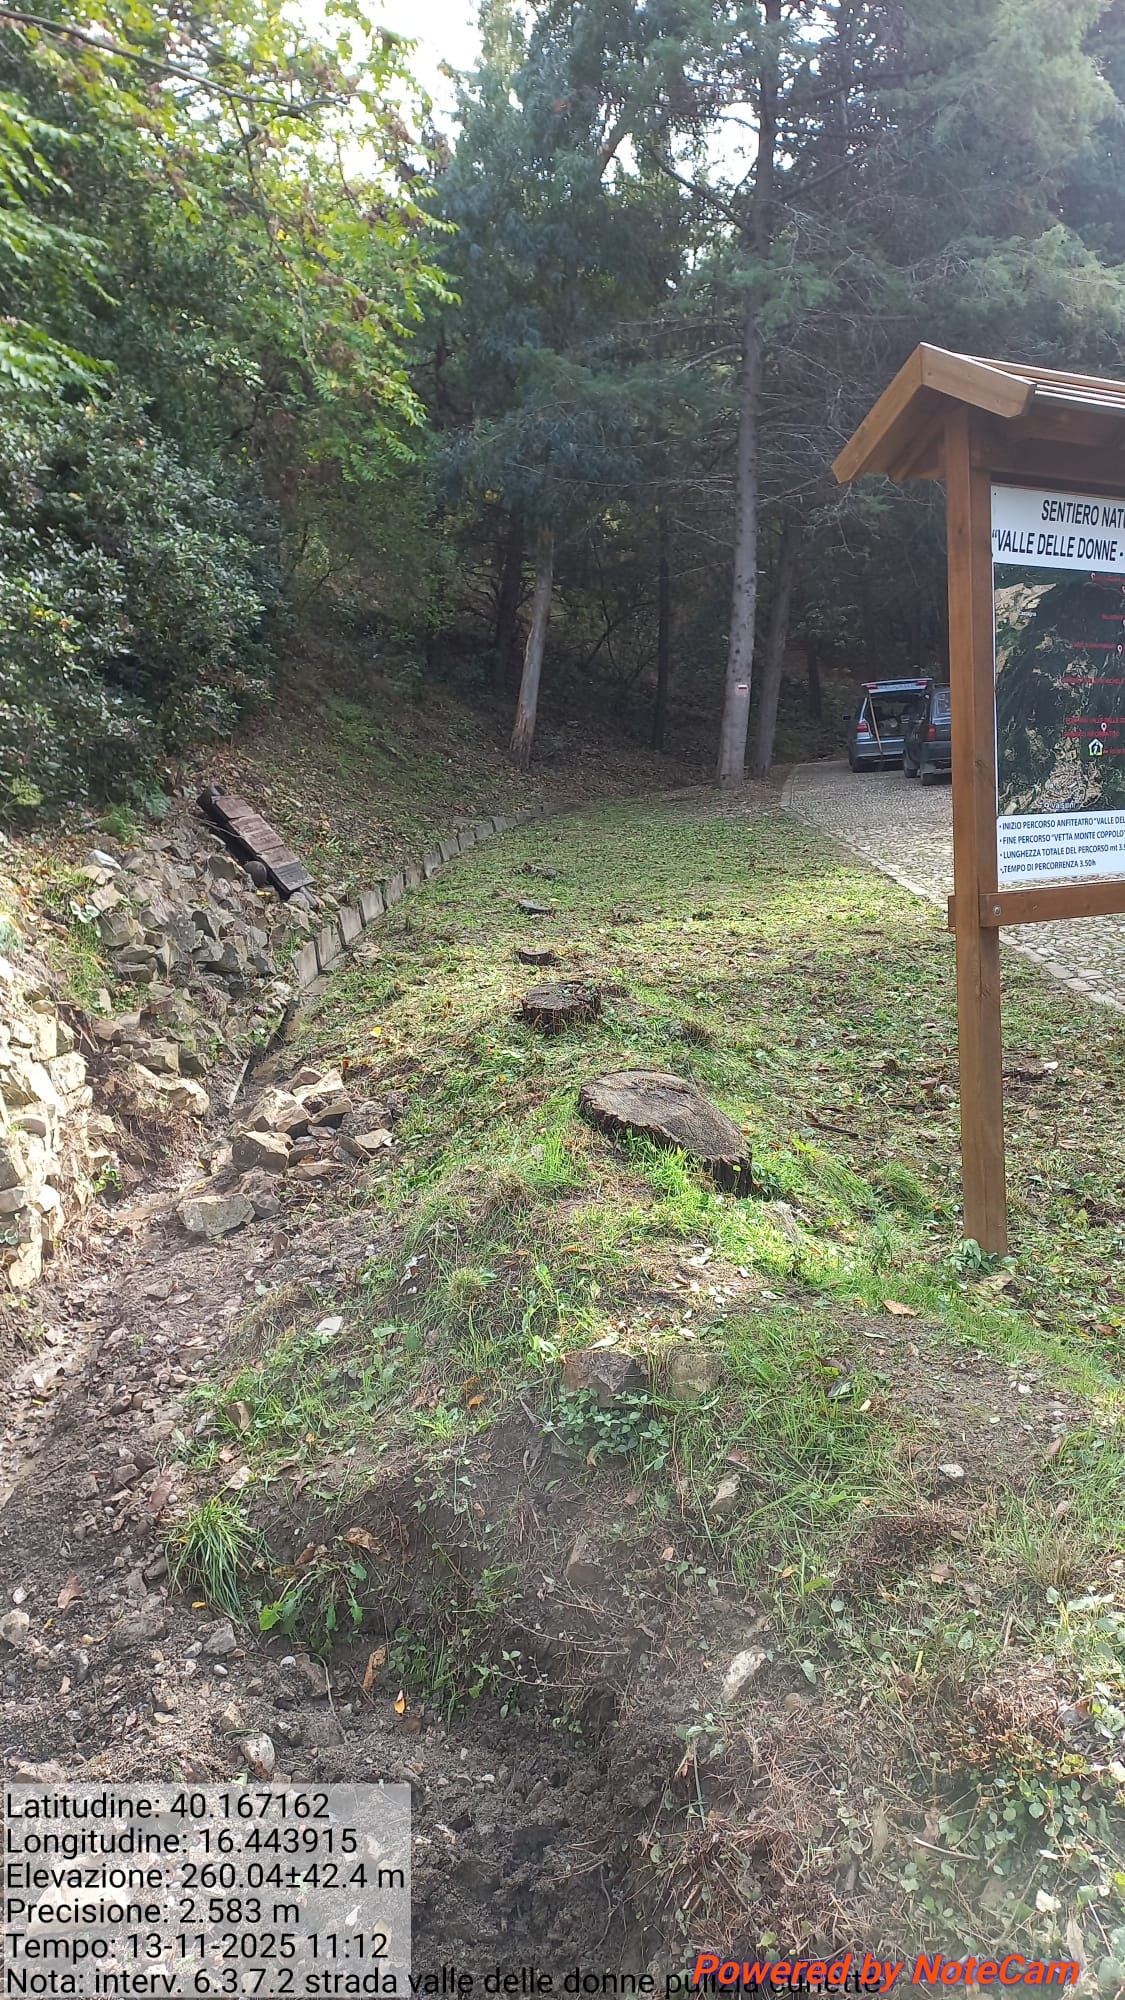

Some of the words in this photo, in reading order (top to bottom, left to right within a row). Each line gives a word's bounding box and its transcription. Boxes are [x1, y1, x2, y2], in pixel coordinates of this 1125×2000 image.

[1041, 500, 1099, 526] SENTIERO
[1037, 533, 1075, 557] DELLE
[1077, 538, 1118, 561] DONNE
[1003, 821, 1021, 830] INIZIO
[1023, 820, 1055, 829] PERCORSO
[1057, 818, 1094, 827] ANFITEATRO
[1003, 836, 1017, 844] FINE
[1018, 834, 1051, 844] PERCORSO
[1074, 832, 1096, 840] MONTE
[1003, 849, 1041, 859] LUNGHEZZA
[1042, 847, 1064, 856] TOTALE
[1065, 846, 1077, 855] DEL
[1078, 844, 1109, 853] PERCORSO
[1027, 863, 1034, 871] DI
[1035, 860, 1079, 870] PERCORRENZA
